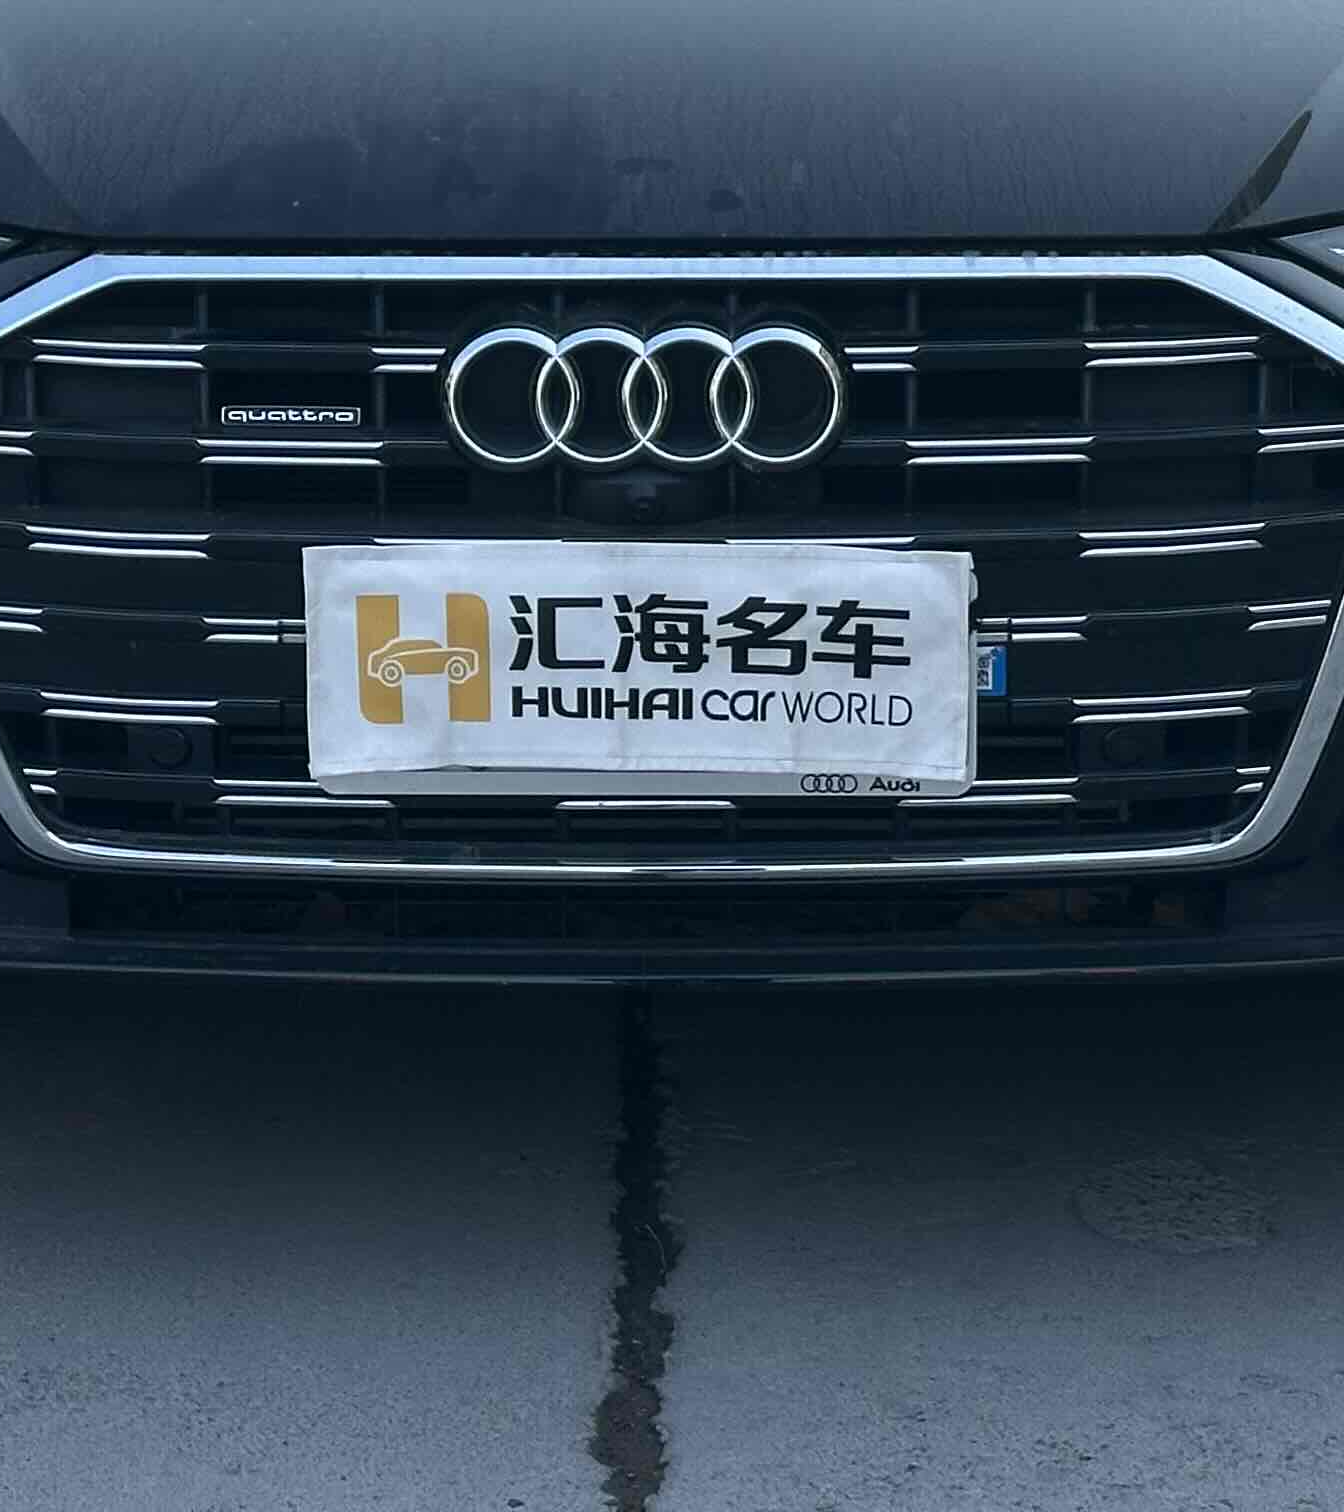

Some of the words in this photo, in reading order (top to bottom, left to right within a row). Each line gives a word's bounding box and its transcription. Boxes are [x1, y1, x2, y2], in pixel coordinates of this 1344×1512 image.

[227, 409, 354, 422] quattro
[508, 593, 911, 679] 汇海名车
[511, 686, 693, 720] HUIHAI
[869, 776, 920, 792] Audi
